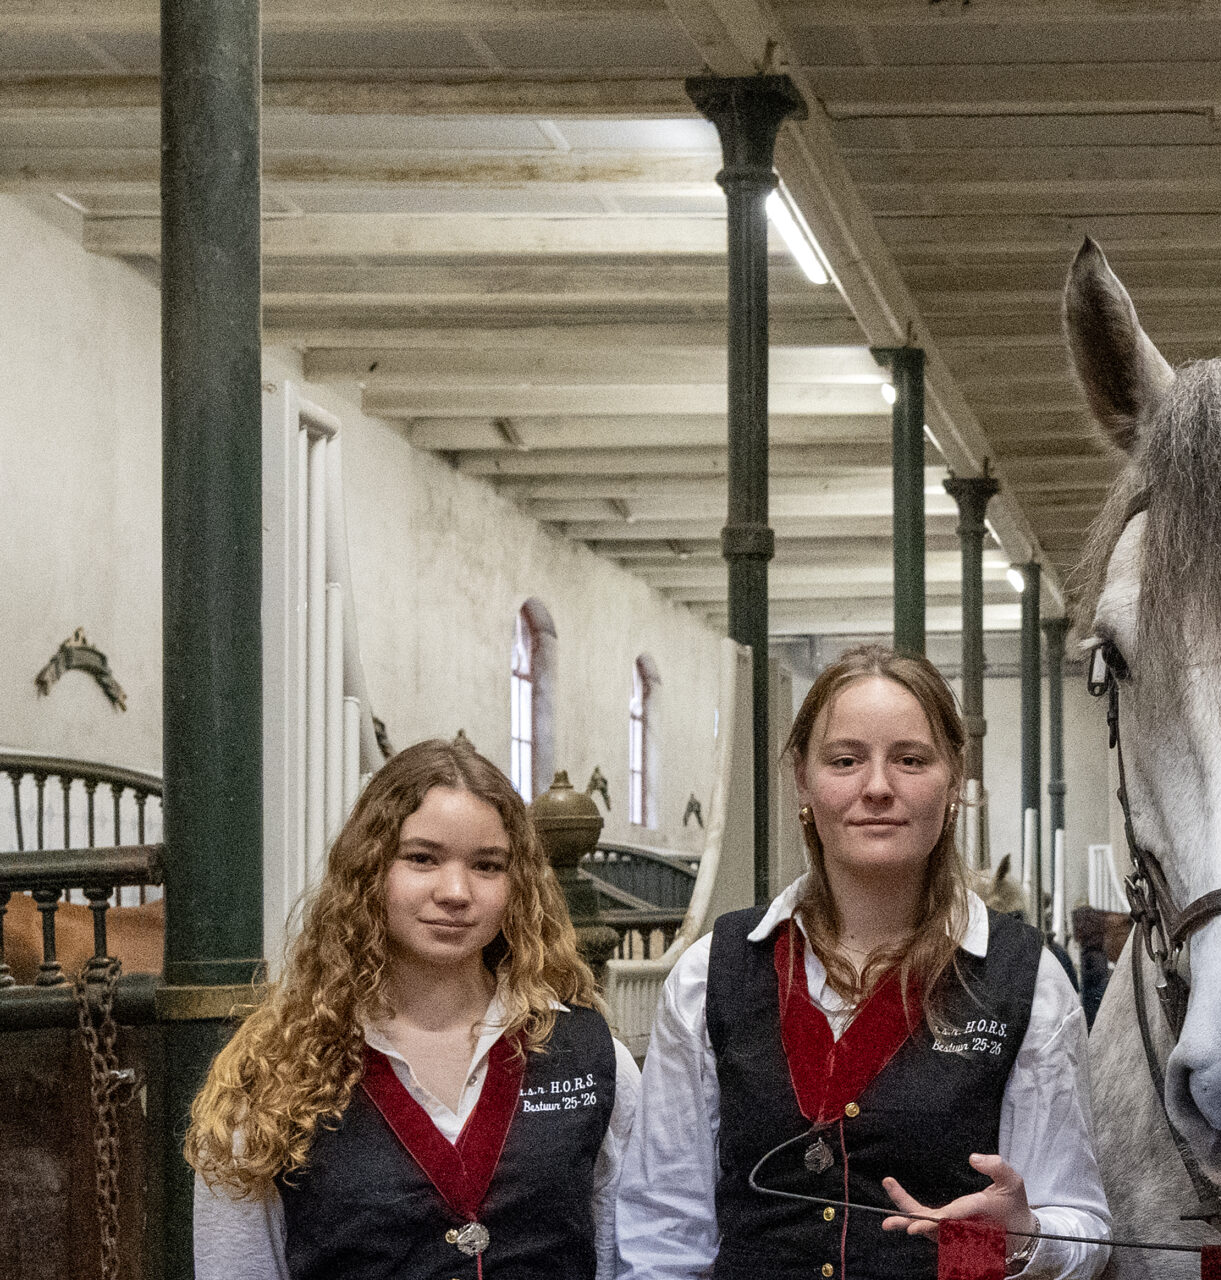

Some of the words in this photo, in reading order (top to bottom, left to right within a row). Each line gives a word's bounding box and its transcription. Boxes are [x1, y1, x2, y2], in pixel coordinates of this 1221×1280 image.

[964, 1019, 1007, 1037] H.O.R.S.
[550, 1073, 597, 1094] H.O.R.S.
[522, 1100, 561, 1112] Bestuur
[562, 1092, 597, 1110] '25-'26
